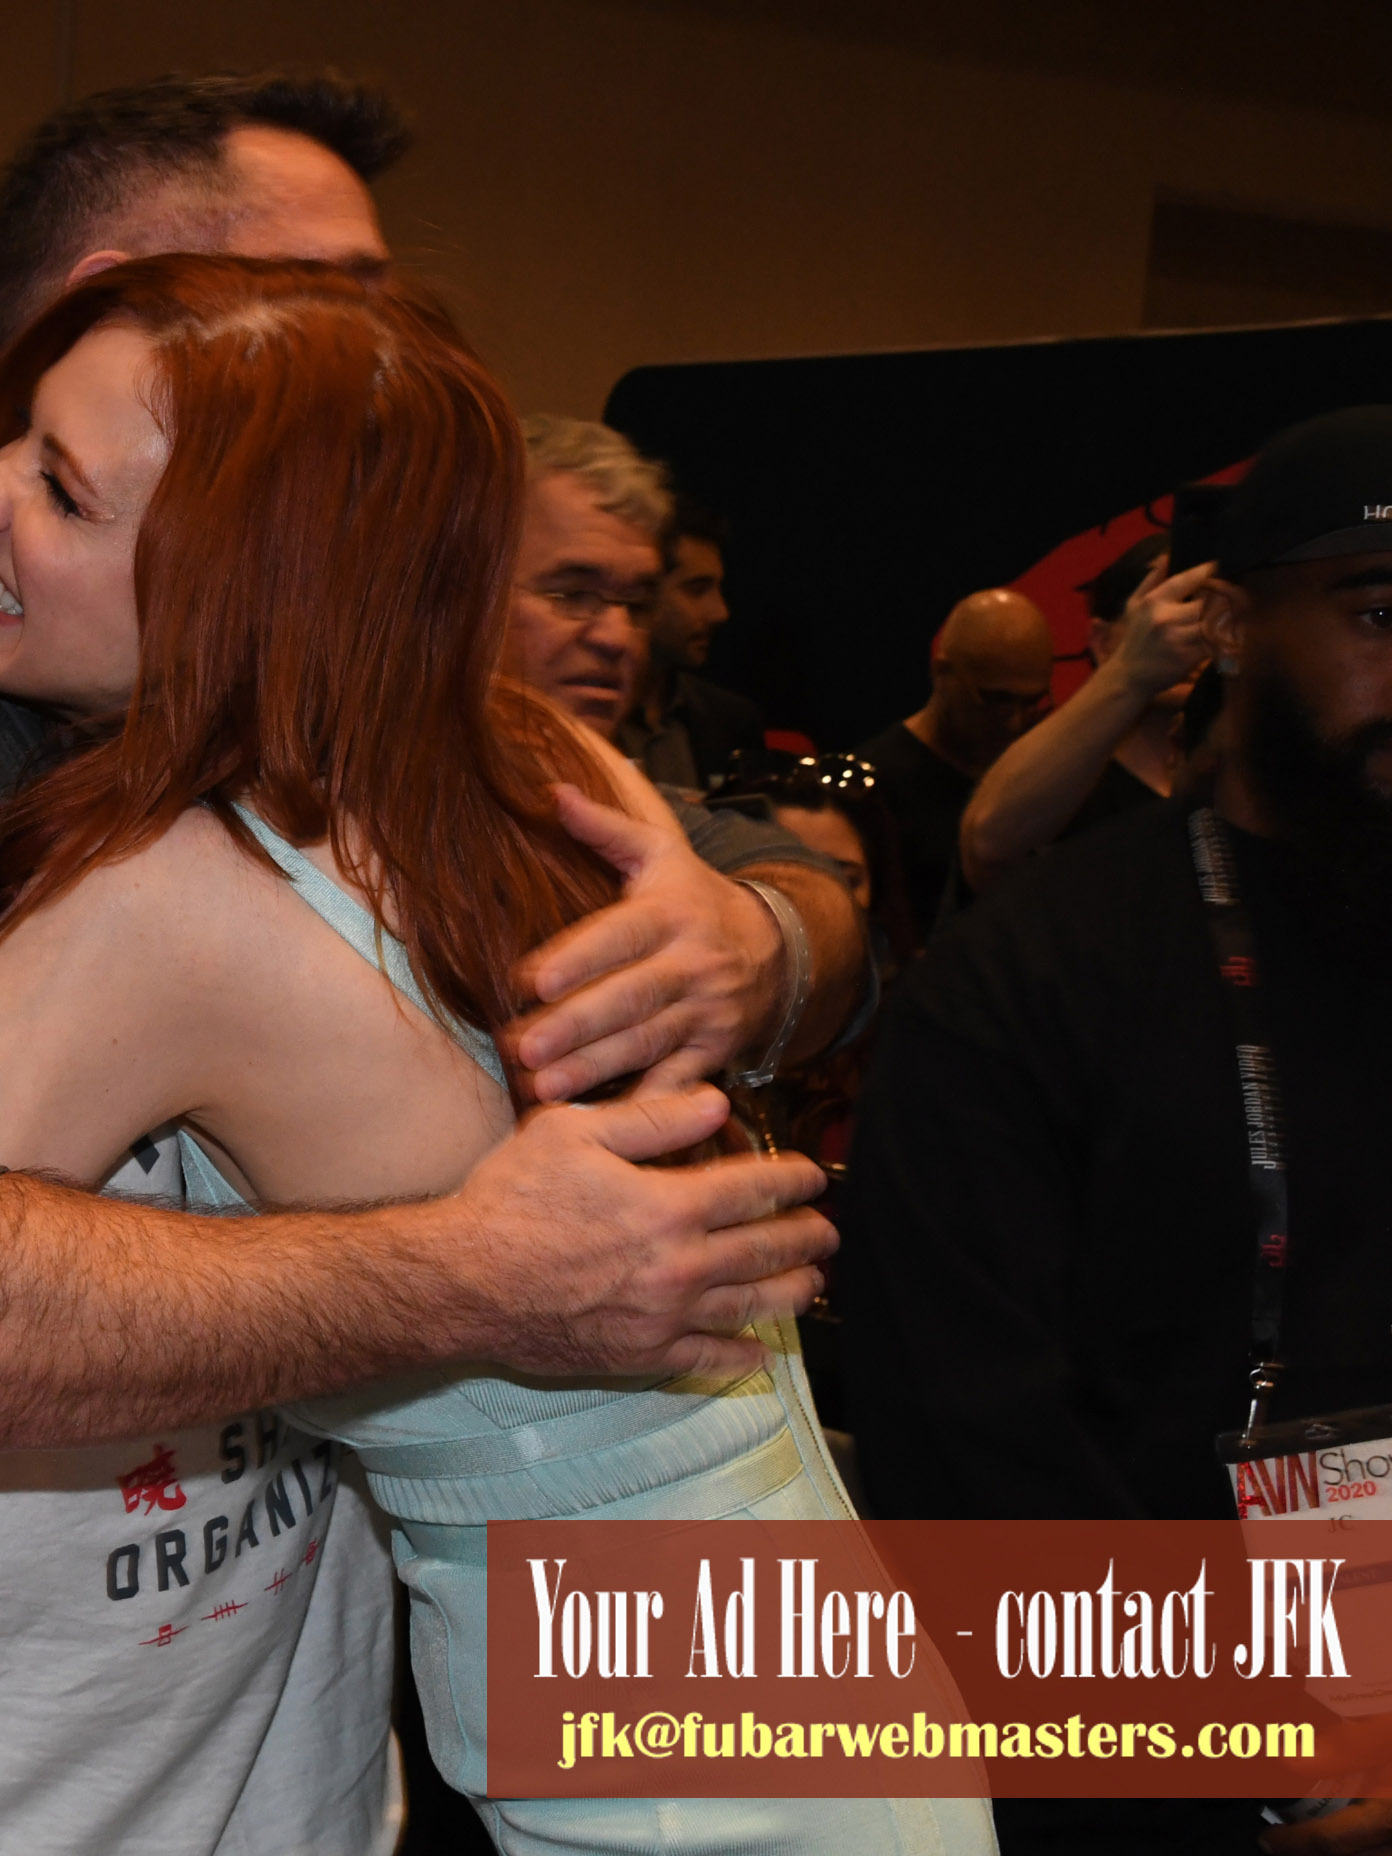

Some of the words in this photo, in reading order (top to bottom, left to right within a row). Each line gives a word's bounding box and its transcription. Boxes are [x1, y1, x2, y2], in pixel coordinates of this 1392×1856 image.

[1236, 1450, 1321, 1520] AVN
[1319, 1447, 1392, 1486] Sho
[1324, 1480, 1377, 1502] 2020
